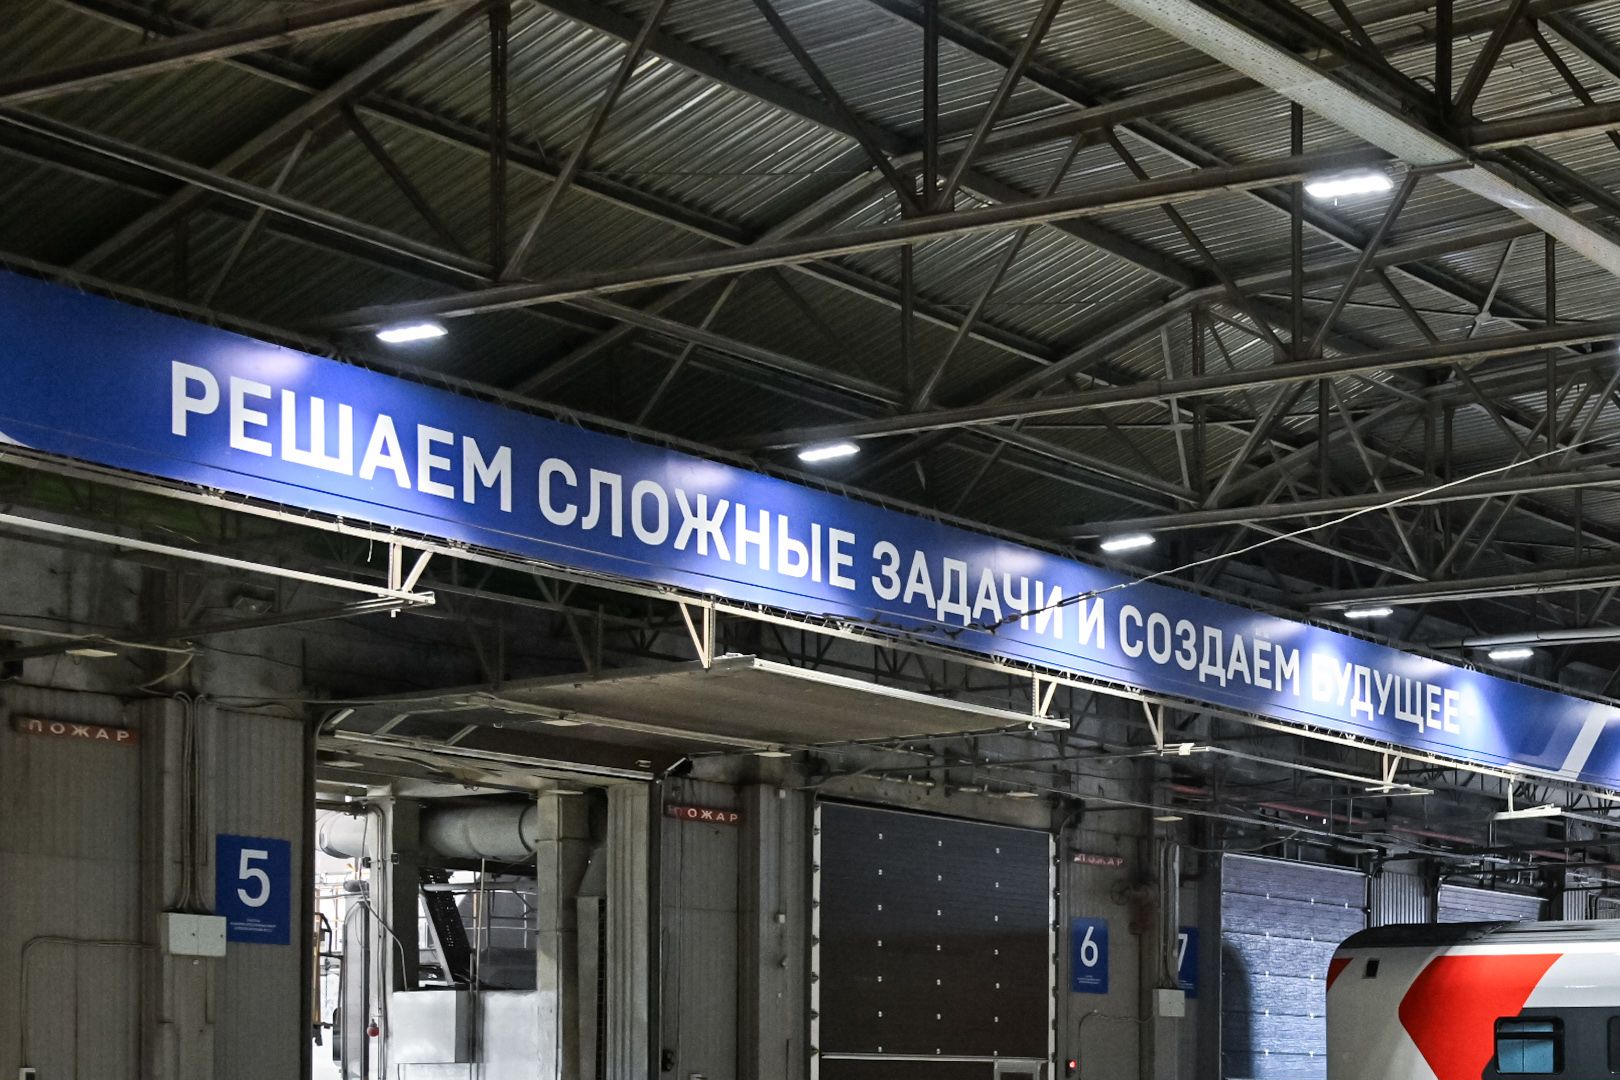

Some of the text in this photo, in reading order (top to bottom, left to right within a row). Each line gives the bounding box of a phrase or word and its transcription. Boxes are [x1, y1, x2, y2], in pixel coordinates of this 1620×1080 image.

[171, 360, 1461, 735] РЕШАЕМ СЛОЖНЫЕ ЗАДАЧИ И СОЗДАЁМ БУДУЩЕЕ
[28, 719, 130, 742] ПОЖАР
[237, 848, 271, 908] 5
[1080, 926, 1099, 968] 6
